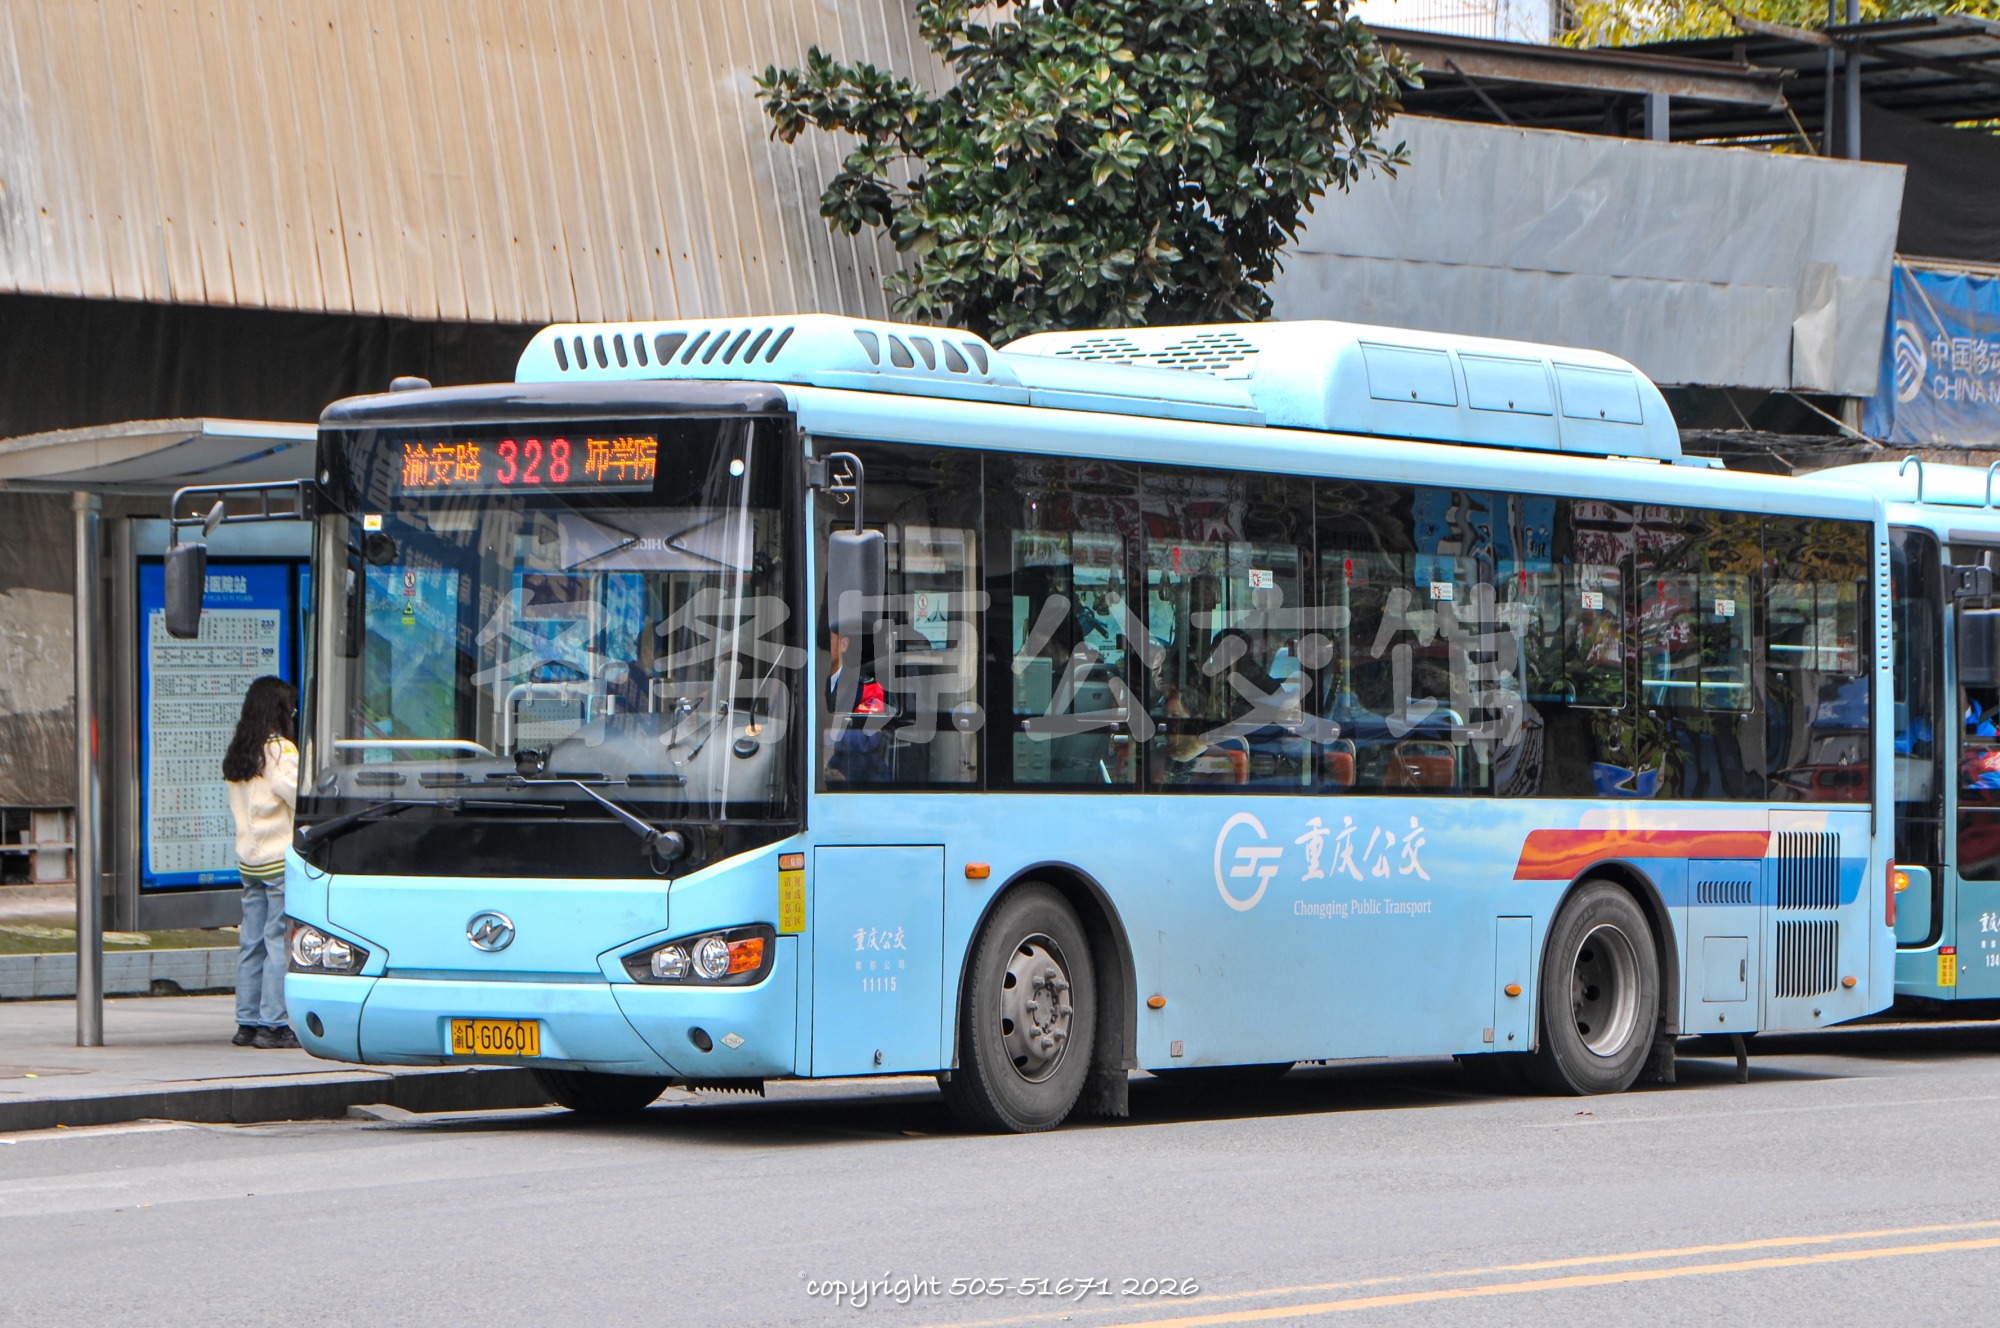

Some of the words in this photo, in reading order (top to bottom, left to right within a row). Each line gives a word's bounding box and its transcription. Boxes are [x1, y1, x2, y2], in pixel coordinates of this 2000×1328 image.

[1932, 375, 1985, 401] CHINA
[402, 441, 481, 486] 渝安路
[497, 438, 571, 484] 328
[204, 575, 247, 593] 医院站
[1294, 816, 1431, 881] 重庆公交
[1294, 901, 1348, 919] Chongqing
[1351, 900, 1381, 915] Public
[1384, 899, 1432, 917] Transport
[1979, 912, 2000, 932] 重庆
[852, 925, 907, 951] 重庆公交
[863, 976, 897, 992] 11115
